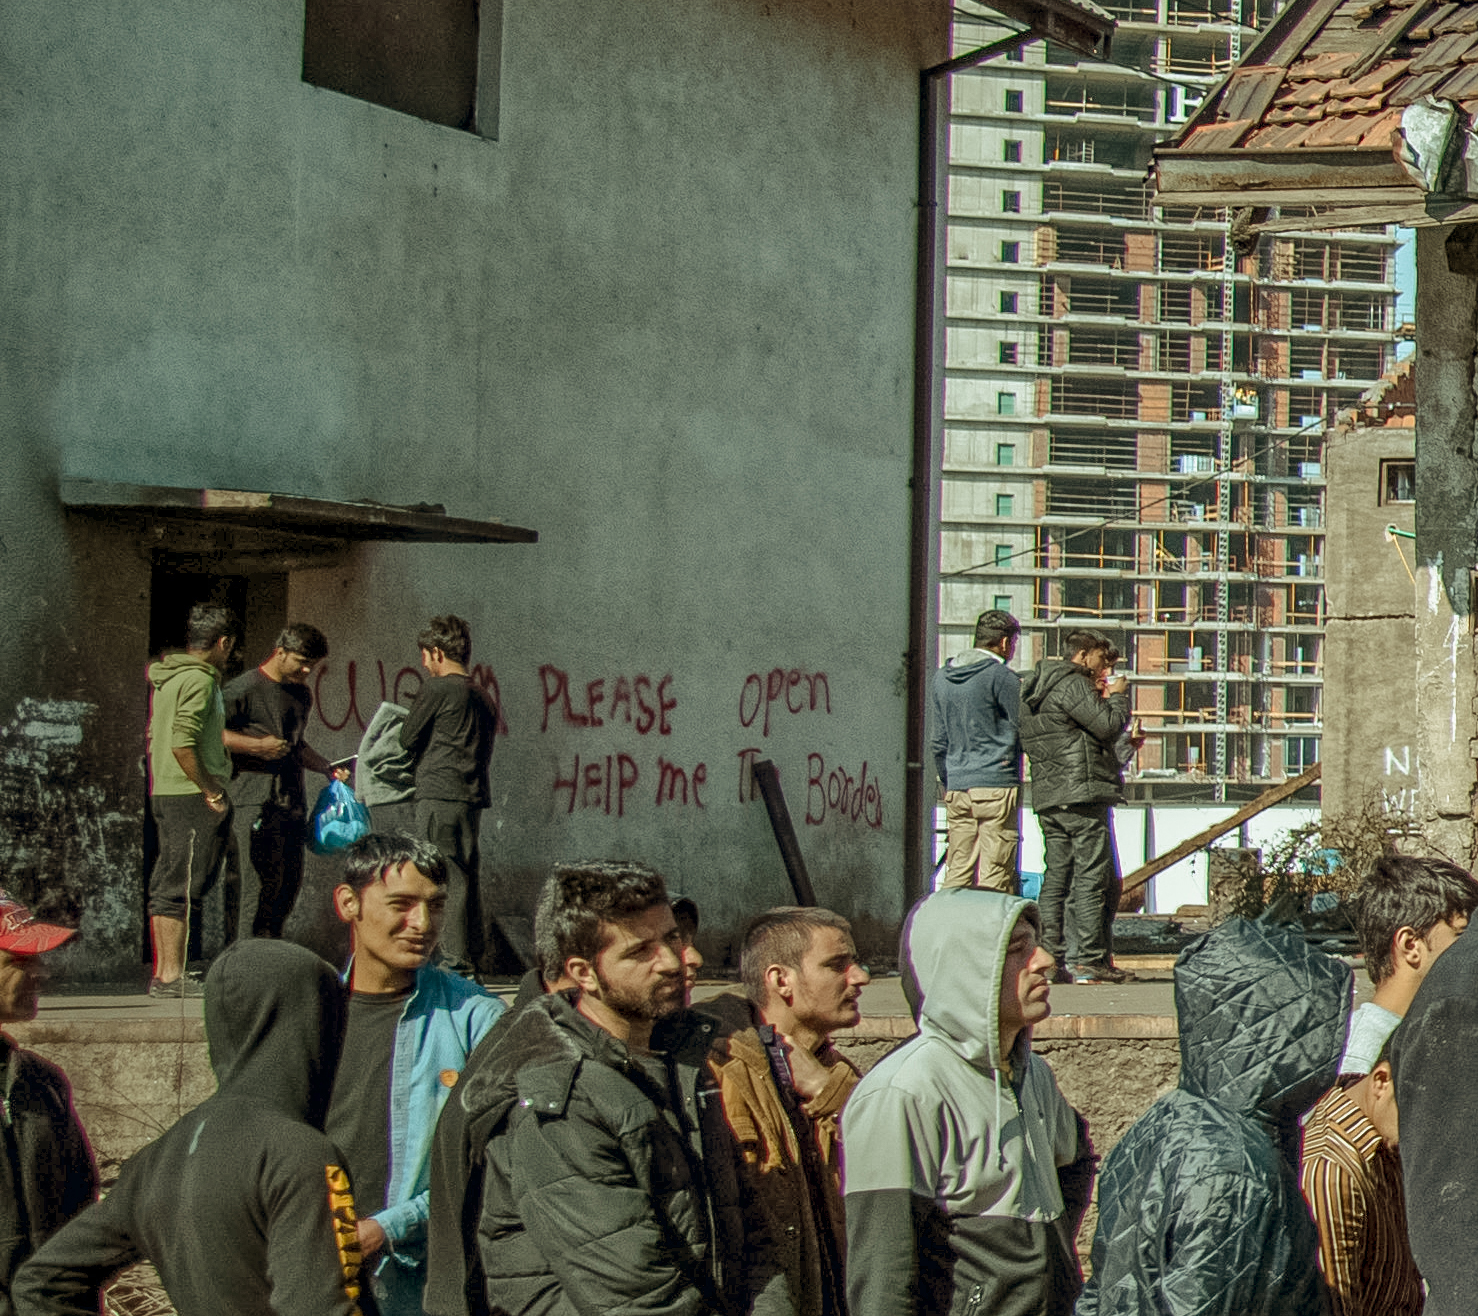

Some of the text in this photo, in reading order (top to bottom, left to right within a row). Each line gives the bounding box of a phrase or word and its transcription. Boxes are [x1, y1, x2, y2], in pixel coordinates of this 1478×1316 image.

[537, 663, 678, 736] PLEASE
[739, 668, 831, 737] open
[656, 755, 706, 809] me
